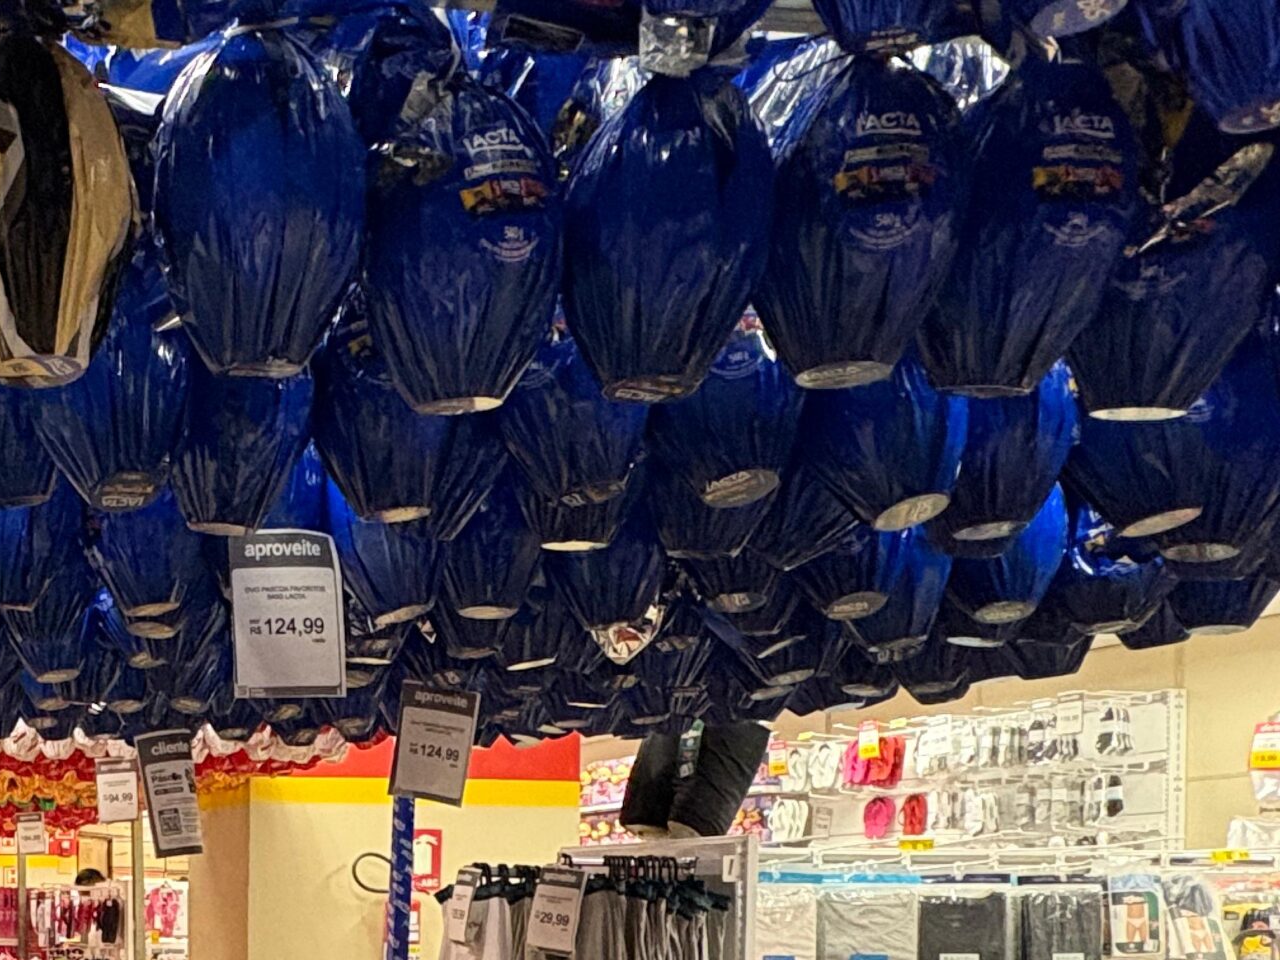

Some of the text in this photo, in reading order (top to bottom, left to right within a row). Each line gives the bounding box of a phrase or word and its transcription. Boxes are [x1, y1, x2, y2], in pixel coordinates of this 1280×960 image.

[856, 111, 922, 137] LACTA
[1054, 115, 1115, 138] LACTA
[463, 127, 531, 157] LACTA
[244, 539, 321, 561] aproveite
[264, 617, 324, 637] 124,99
[420, 744, 460, 762] 124,99
[540, 911, 569, 927] 29,99
